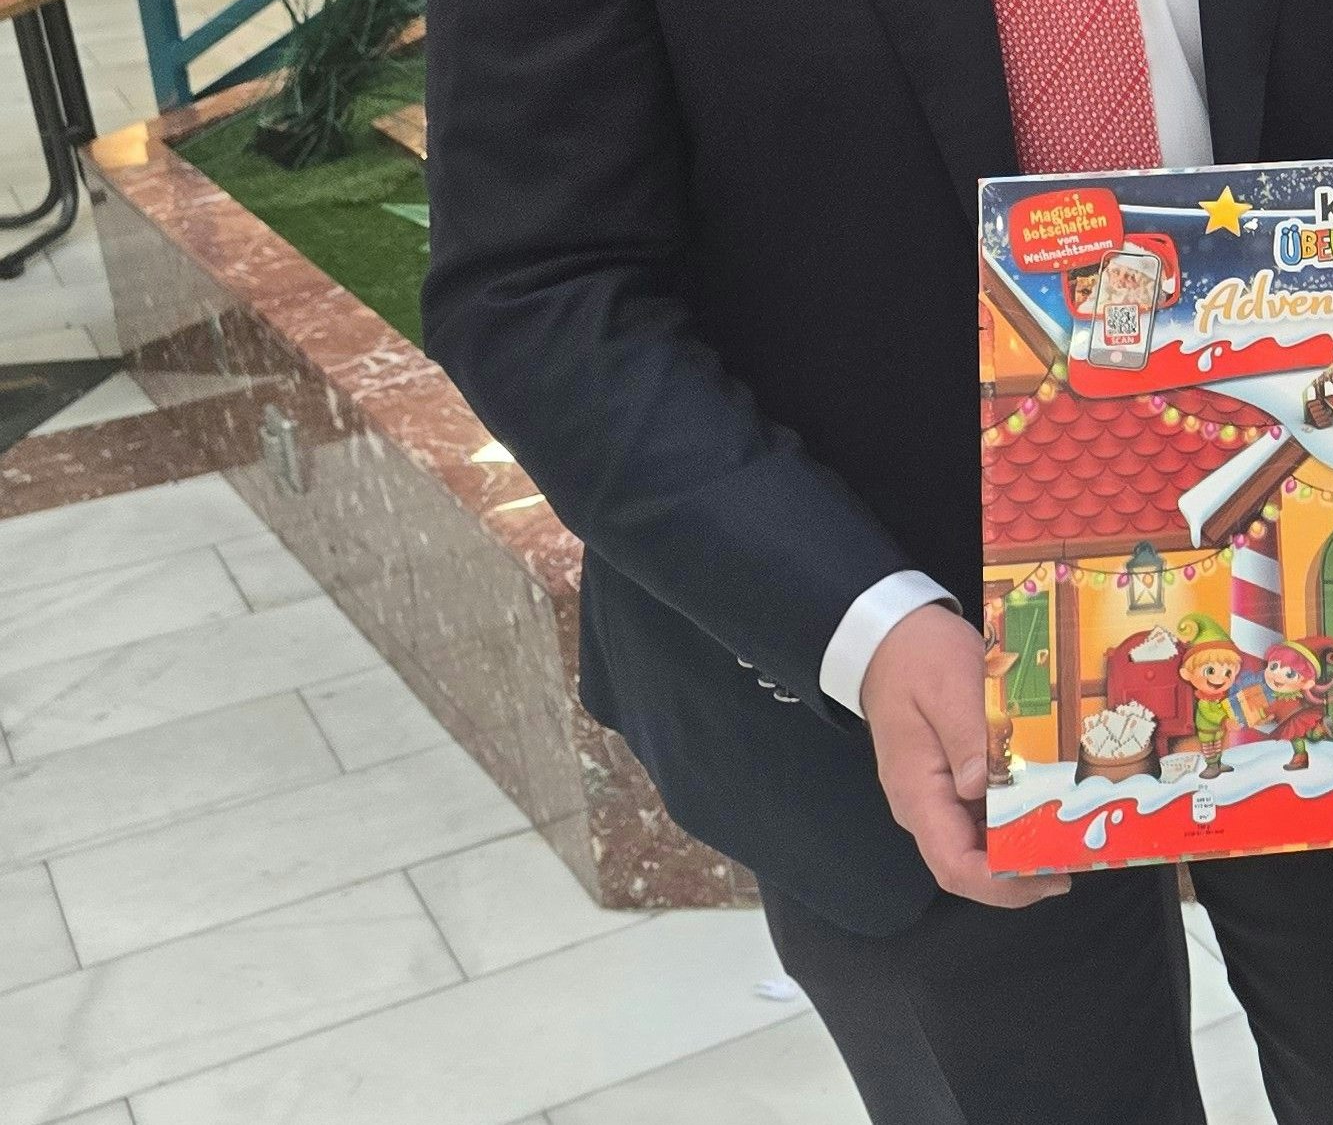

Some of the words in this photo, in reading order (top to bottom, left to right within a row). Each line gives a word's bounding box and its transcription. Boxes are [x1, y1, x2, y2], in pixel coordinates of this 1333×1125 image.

[1030, 199, 1094, 225] Magische
[1023, 216, 1107, 242] Botschaften
[1057, 235, 1080, 246] vom
[1023, 239, 1113, 265] Weihnachtsmann
[1110, 336, 1135, 345] SCAN
